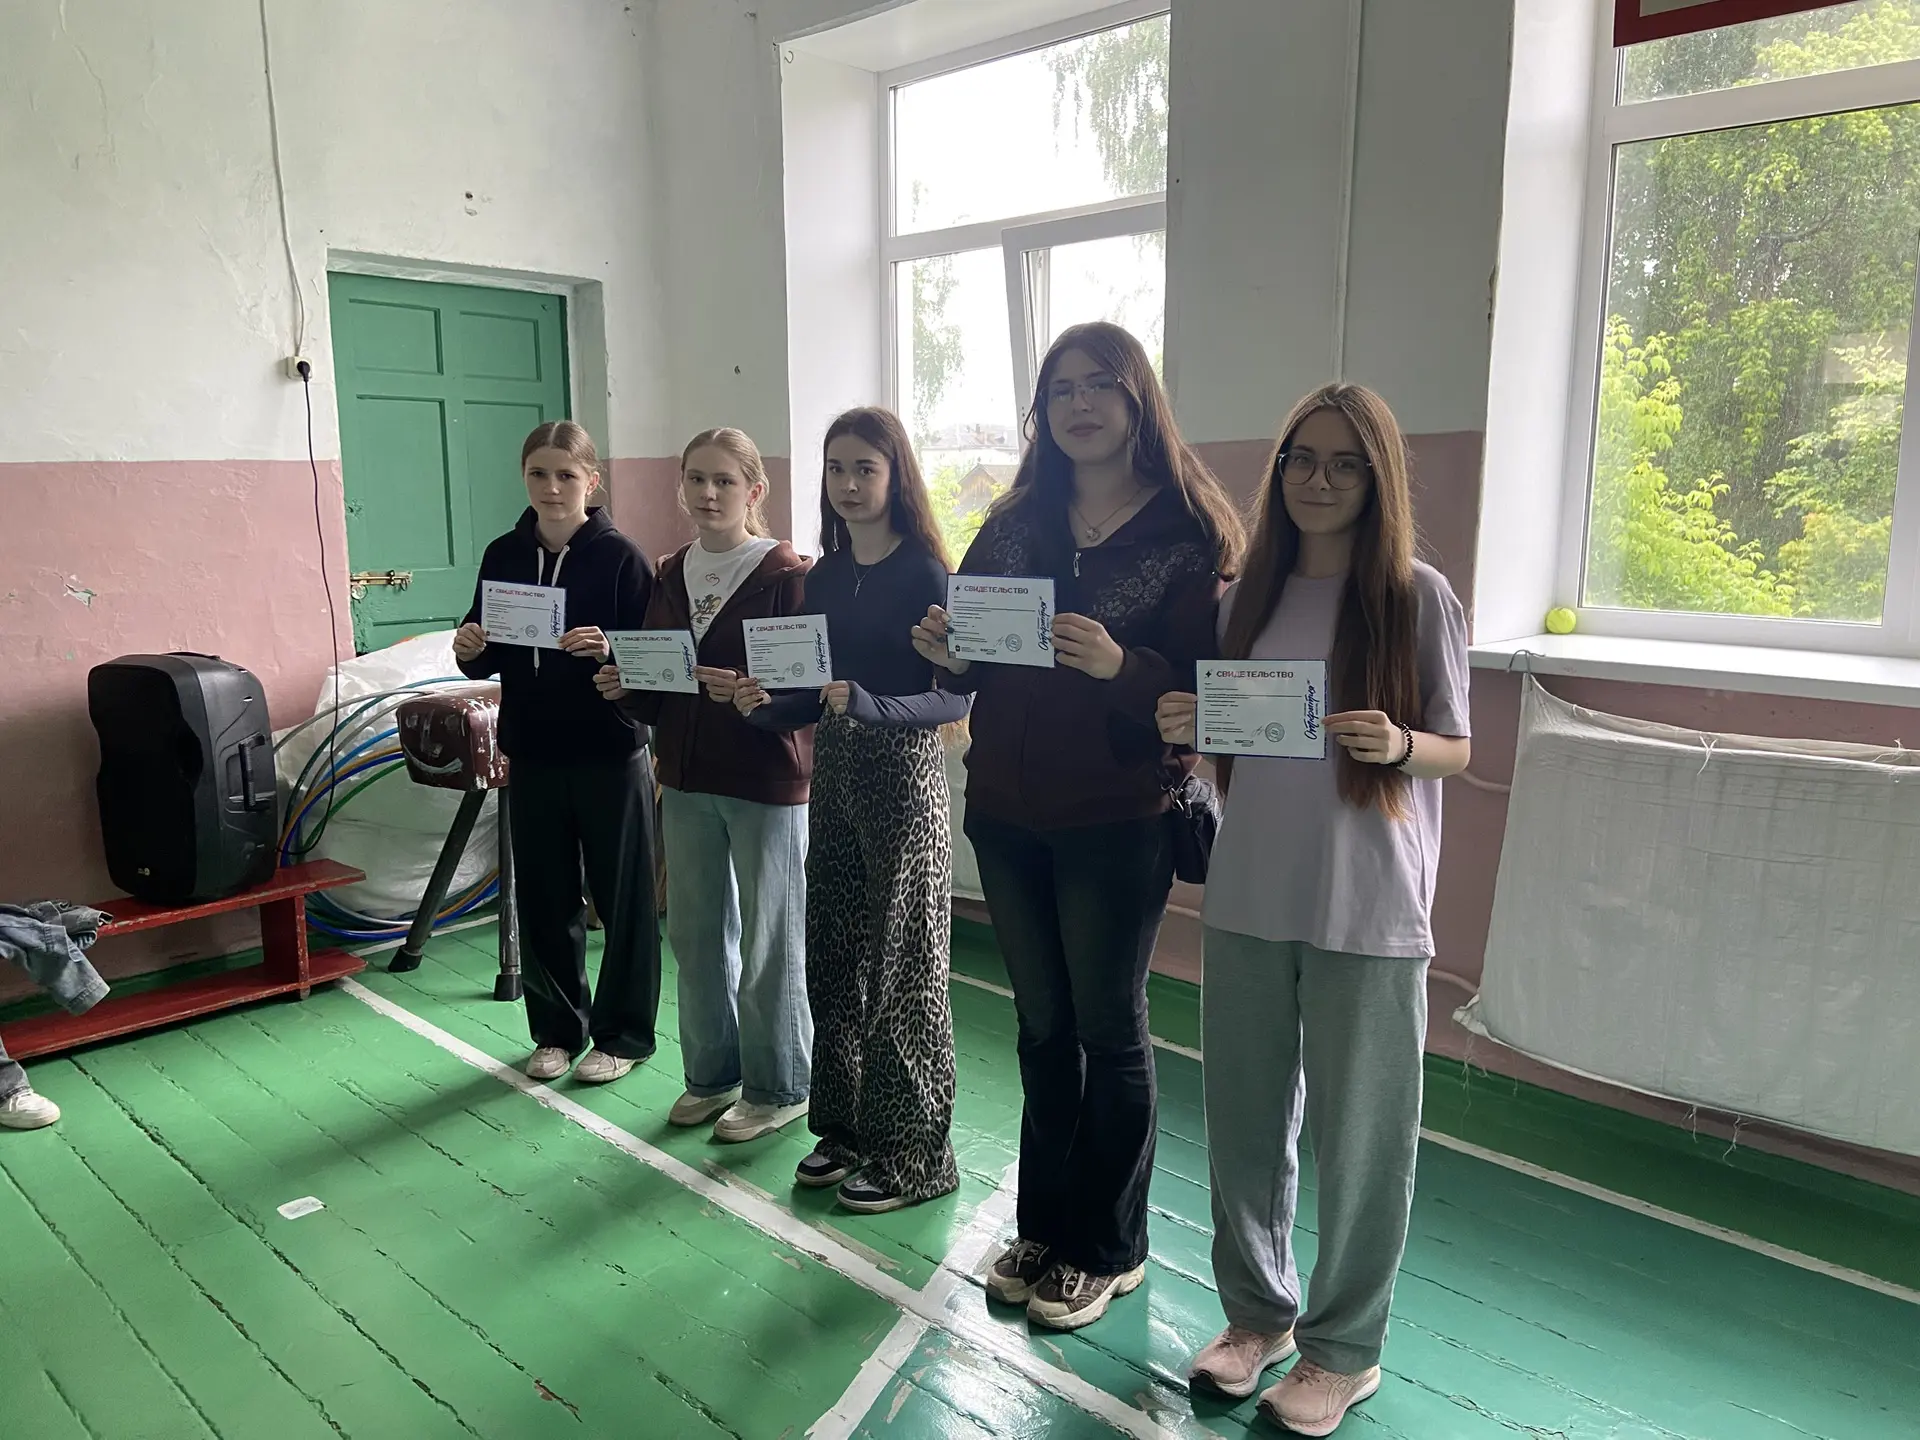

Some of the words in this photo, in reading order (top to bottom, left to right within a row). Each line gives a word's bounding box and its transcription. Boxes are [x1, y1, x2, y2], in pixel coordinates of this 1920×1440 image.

[964, 585, 1029, 594] СВИДЕТЕЛЬСТВО
[756, 623, 807, 632] СВИДЕТЕЛЬСТВО
[1216, 670, 1294, 678] СВИДЕТЕЛЬСТВО
